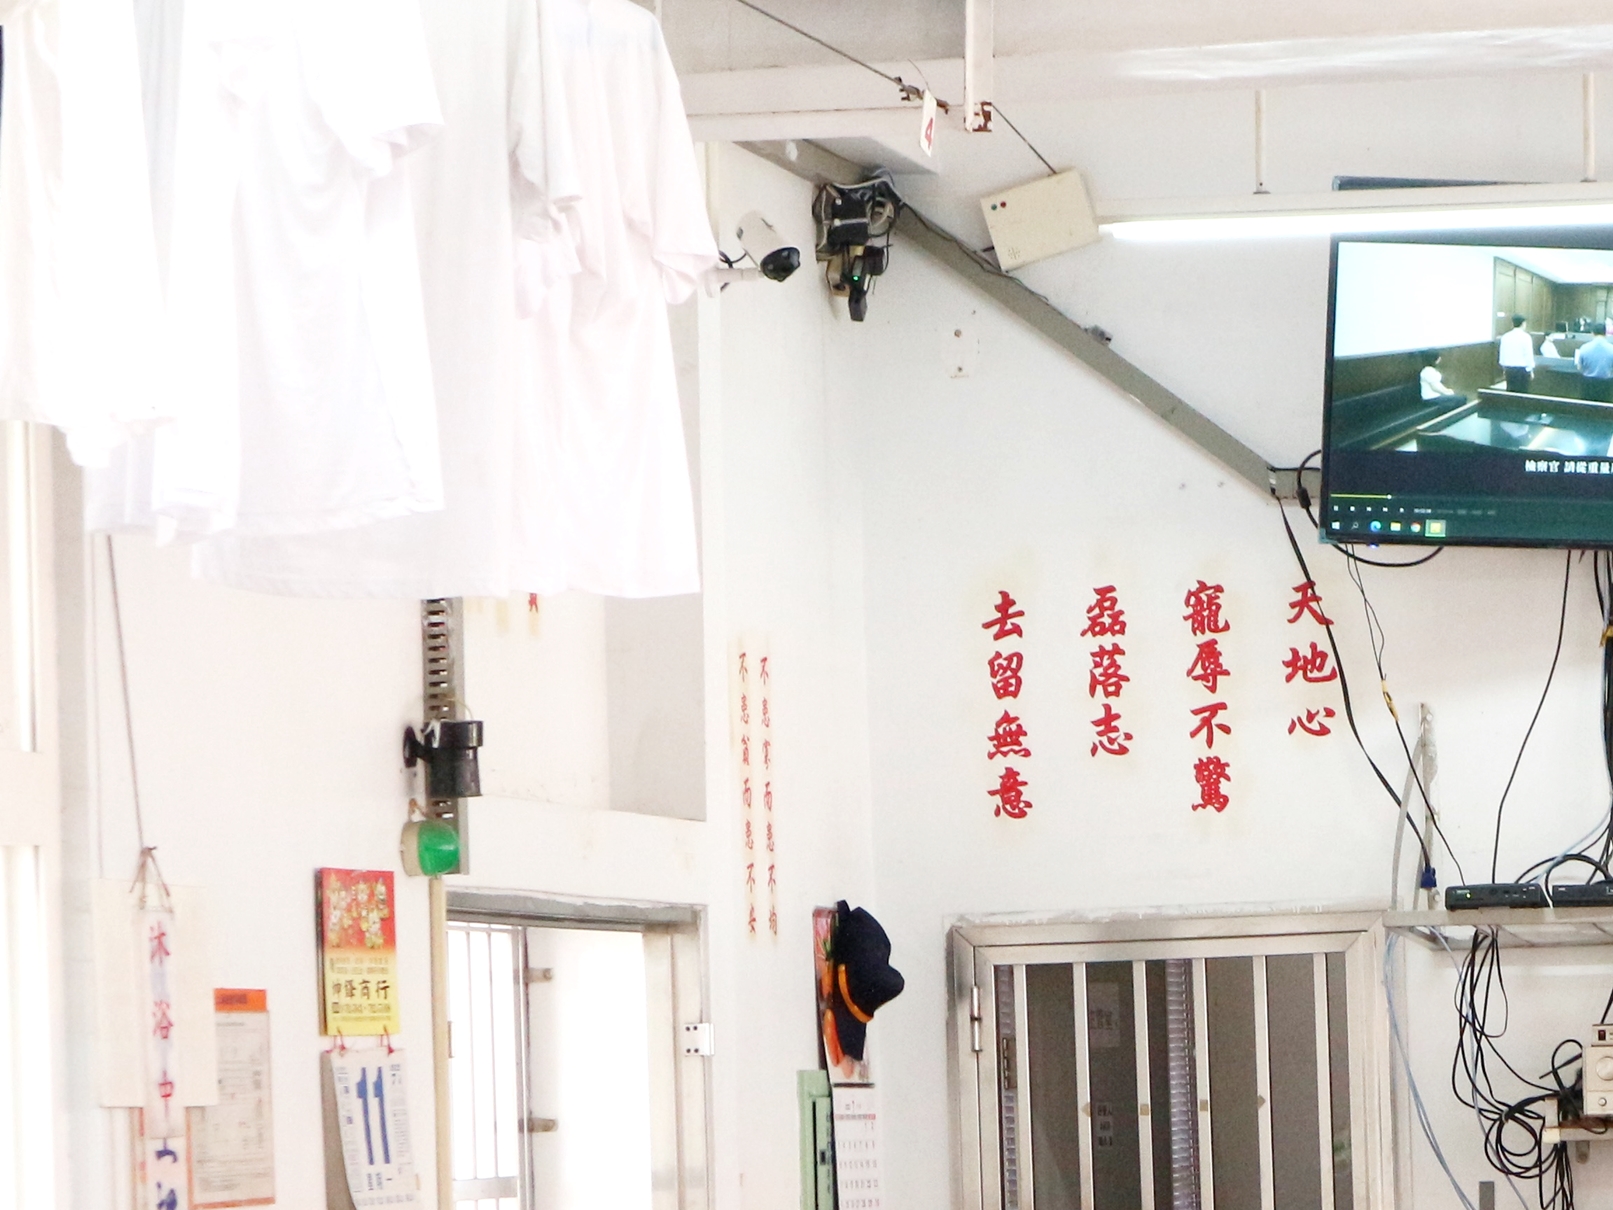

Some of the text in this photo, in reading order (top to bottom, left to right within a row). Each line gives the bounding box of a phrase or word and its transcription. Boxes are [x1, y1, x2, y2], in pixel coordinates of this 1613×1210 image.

[981, 590, 1033, 819] 去留無意
[1080, 584, 1133, 757] 磊落志
[1183, 579, 1231, 813] 寵辱不驚
[1282, 580, 1338, 737] 天地心
